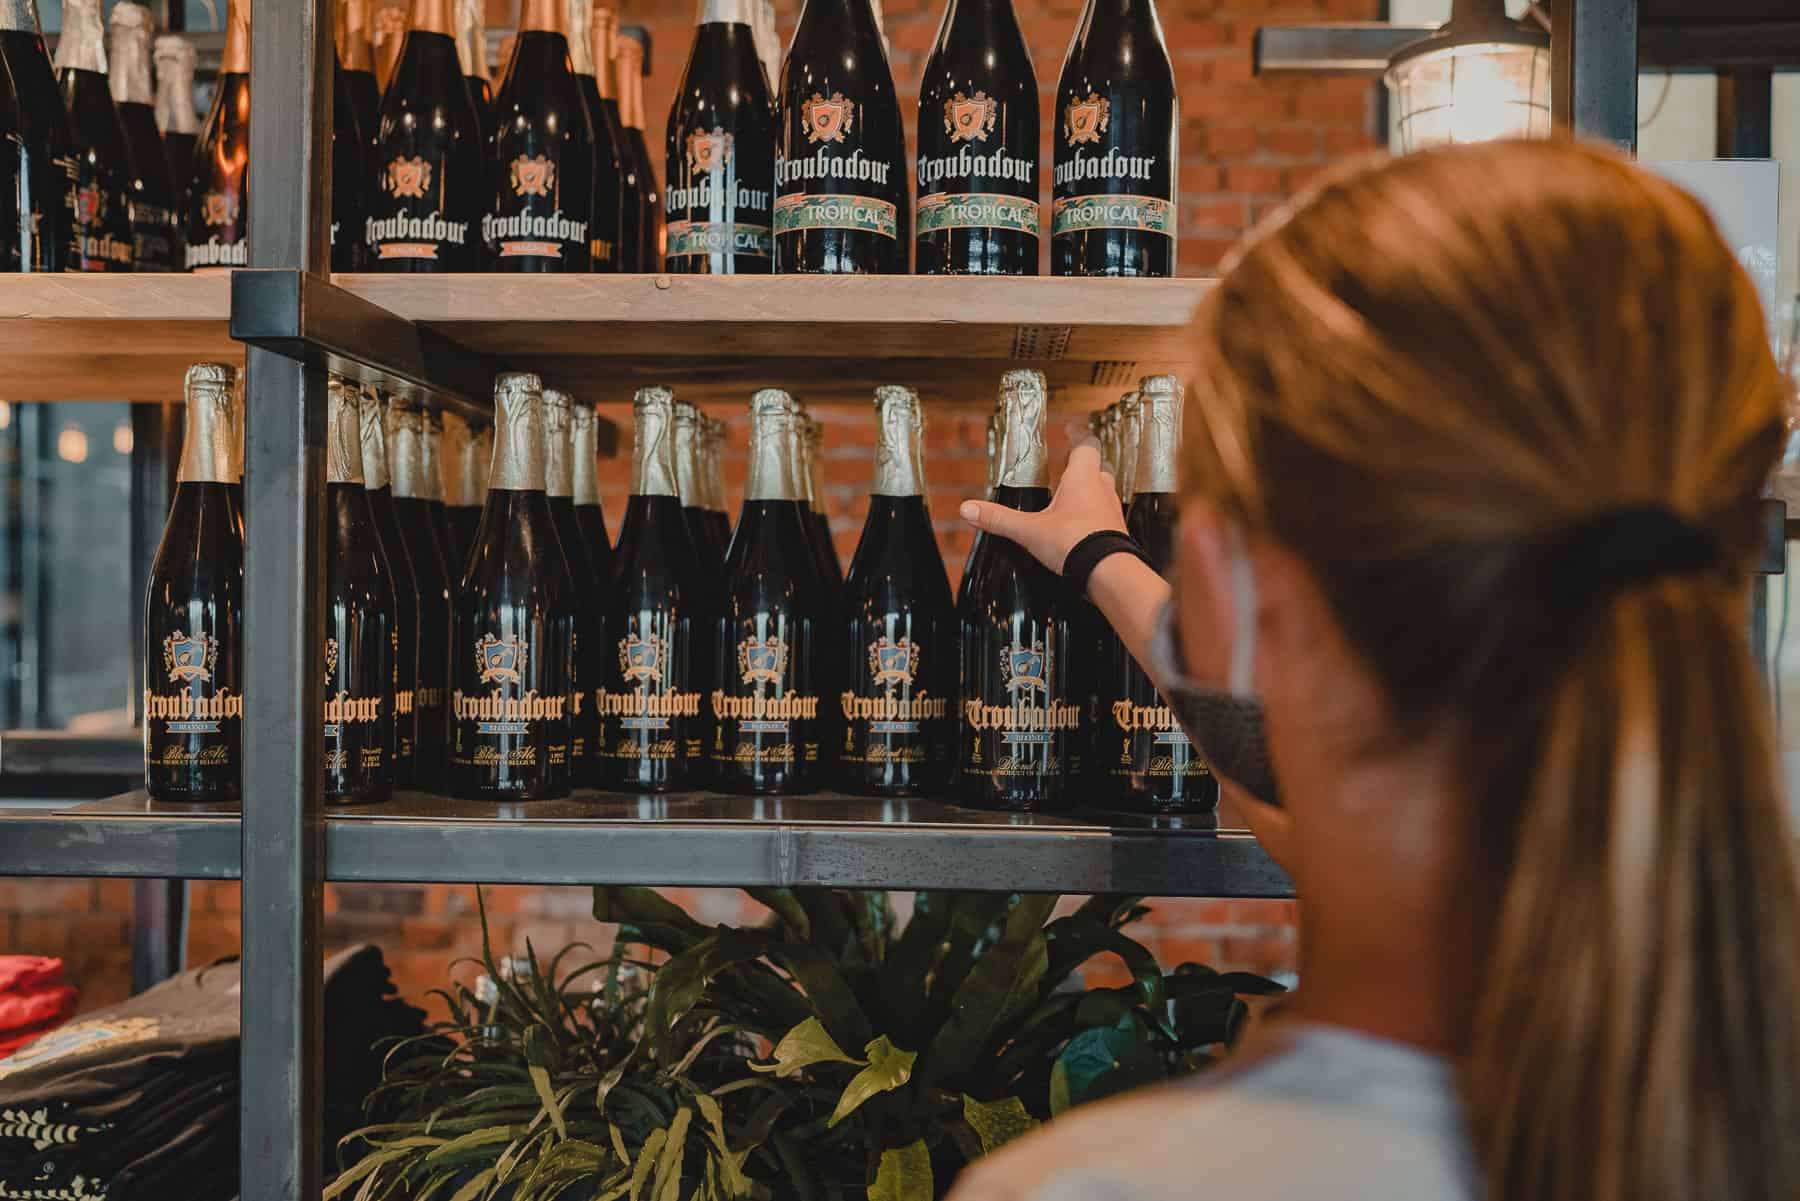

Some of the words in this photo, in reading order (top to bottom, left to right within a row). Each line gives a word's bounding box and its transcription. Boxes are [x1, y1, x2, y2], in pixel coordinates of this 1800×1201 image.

[1054, 146, 1156, 188] oubadour
[808, 204, 880, 224] TROPICAL
[949, 203, 1025, 224] TROPICAL
[1065, 203, 1139, 225] TROPICAL
[453, 688, 567, 721] Troubadour
[596, 685, 702, 718] Troubadour
[712, 688, 819, 720] Troubadour
[840, 688, 946, 721] Troubadour
[965, 697, 1081, 733] Troubadour
